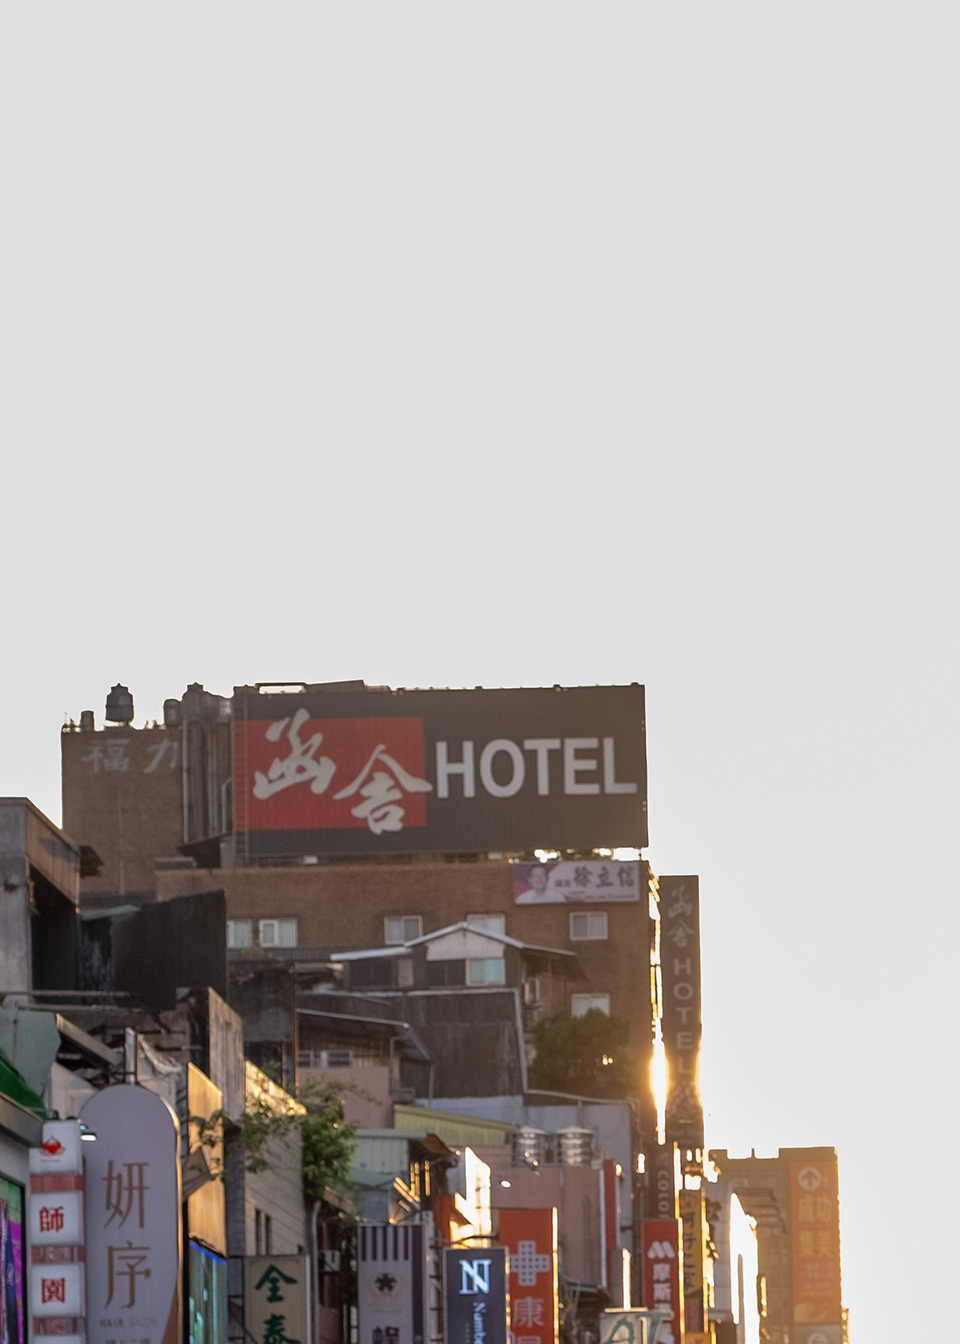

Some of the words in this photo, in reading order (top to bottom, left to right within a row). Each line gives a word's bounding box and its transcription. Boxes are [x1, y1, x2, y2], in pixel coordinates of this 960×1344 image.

[434, 737, 638, 799] HOTEL
[673, 958, 695, 1075] HOTEL
[102, 1159, 151, 1309] 妍序
